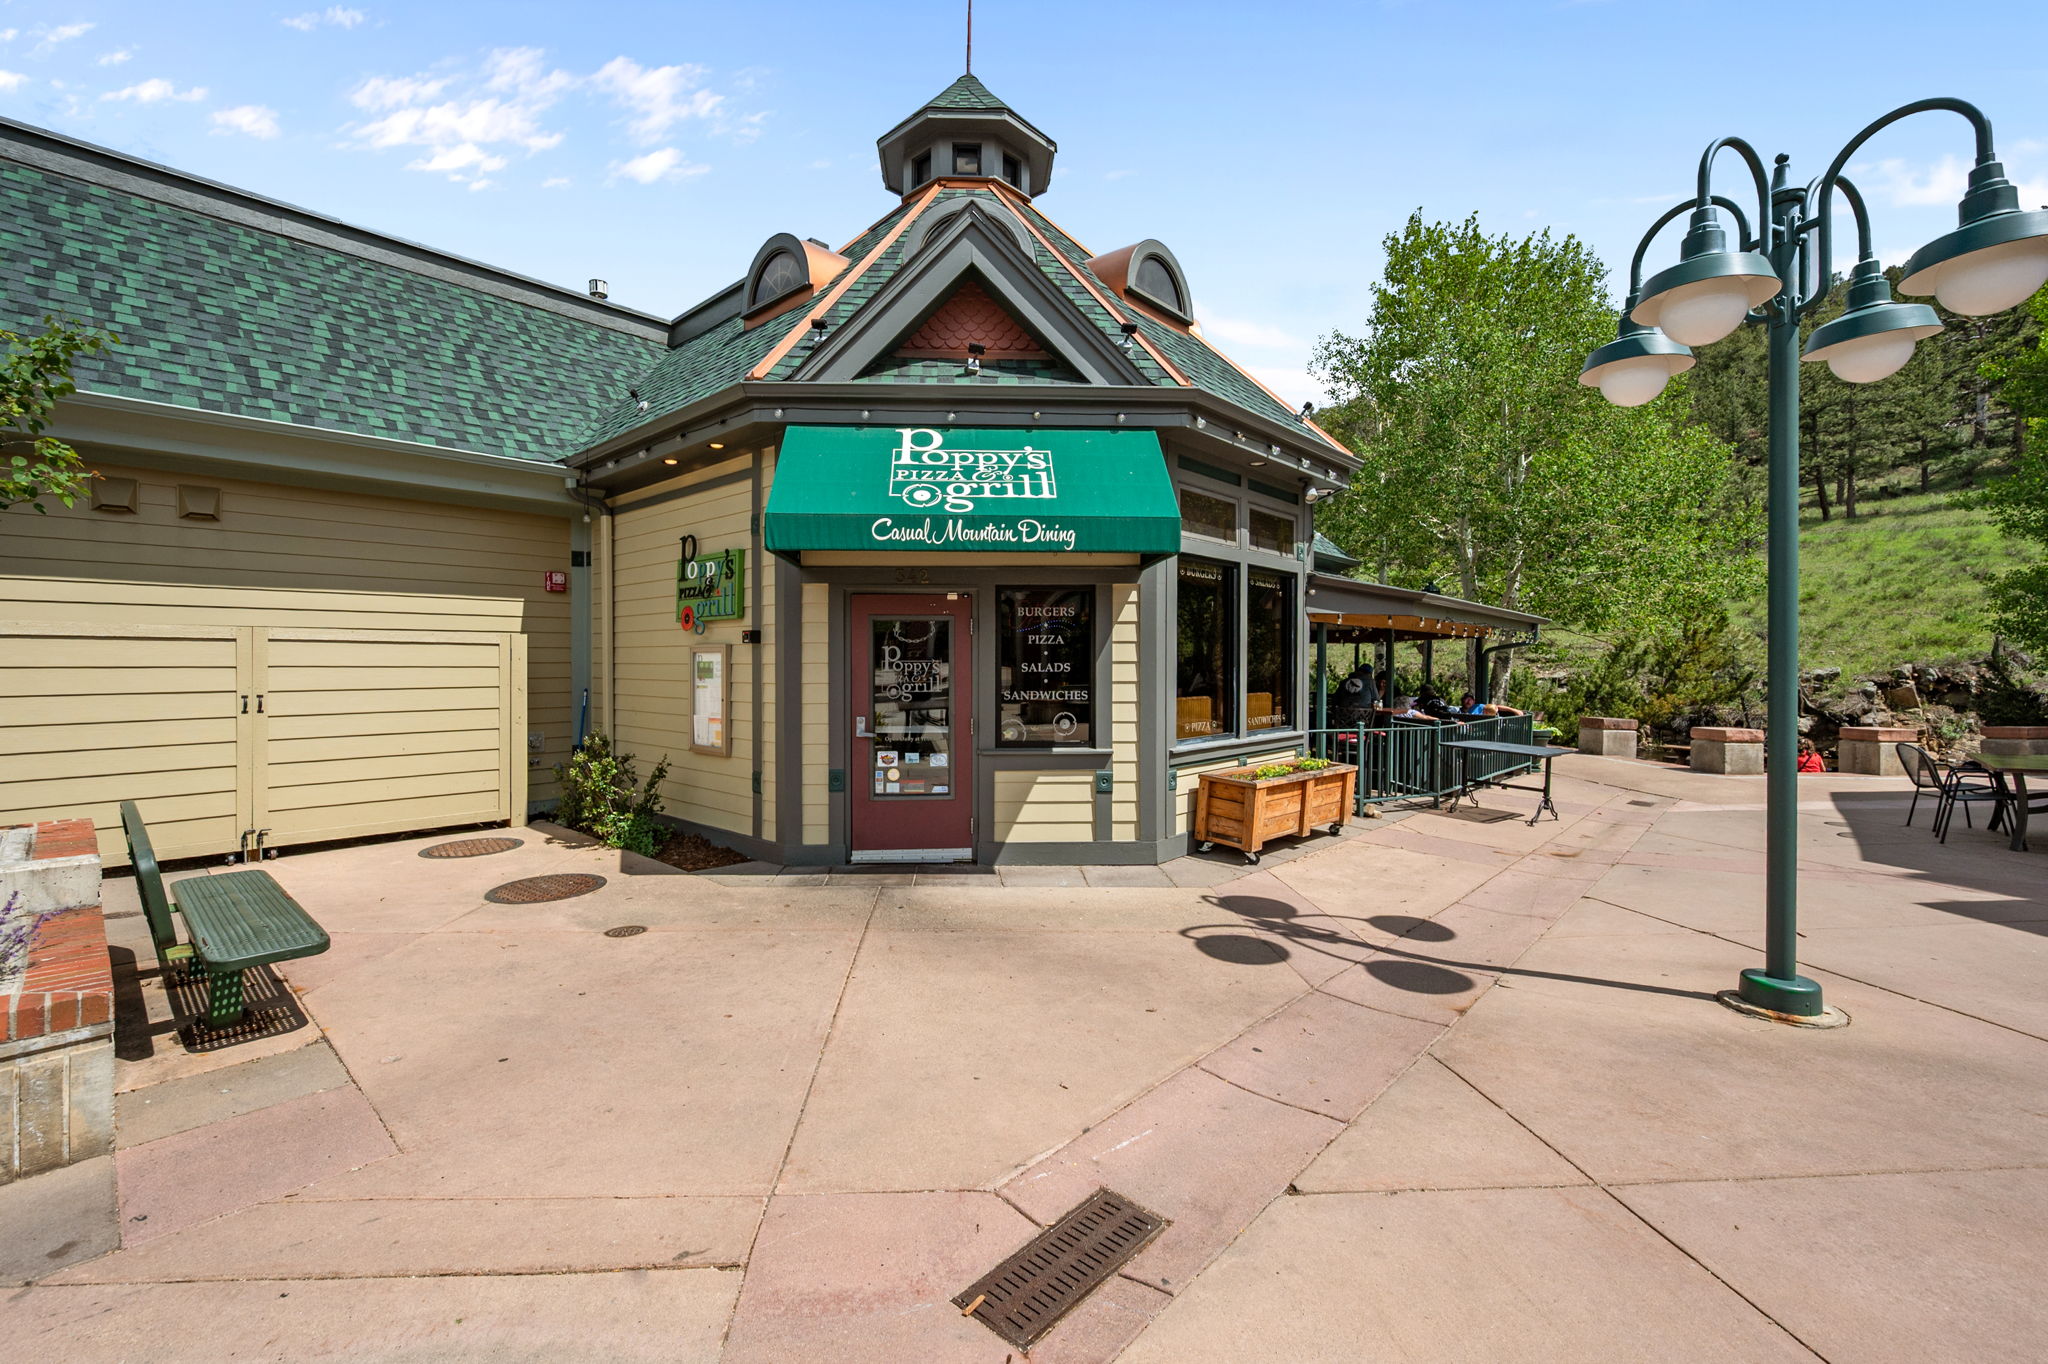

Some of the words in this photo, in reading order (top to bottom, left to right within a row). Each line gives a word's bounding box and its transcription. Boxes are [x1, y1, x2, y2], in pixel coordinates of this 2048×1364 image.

[895, 428, 1047, 475] Poppy's
[895, 469, 965, 481] PIZZA
[972, 465, 1002, 482] &
[944, 471, 1054, 513] grill
[871, 517, 933, 544] Casual
[932, 519, 1018, 545] Mountain
[1017, 519, 1076, 550] Dining
[679, 534, 734, 588] Poppy's
[679, 586, 703, 599] PIZZA
[694, 581, 735, 635] grill
[1017, 606, 1075, 617] BURGERS
[1028, 634, 1065, 645] PIZZA
[882, 645, 941, 676] Poppy's
[1021, 662, 1071, 673] SALADS
[901, 675, 941, 702] grill
[1003, 690, 1088, 701] SANDWICHES
[1191, 721, 1211, 732] PIZZA
[1247, 714, 1282, 726] SANDWICHES
